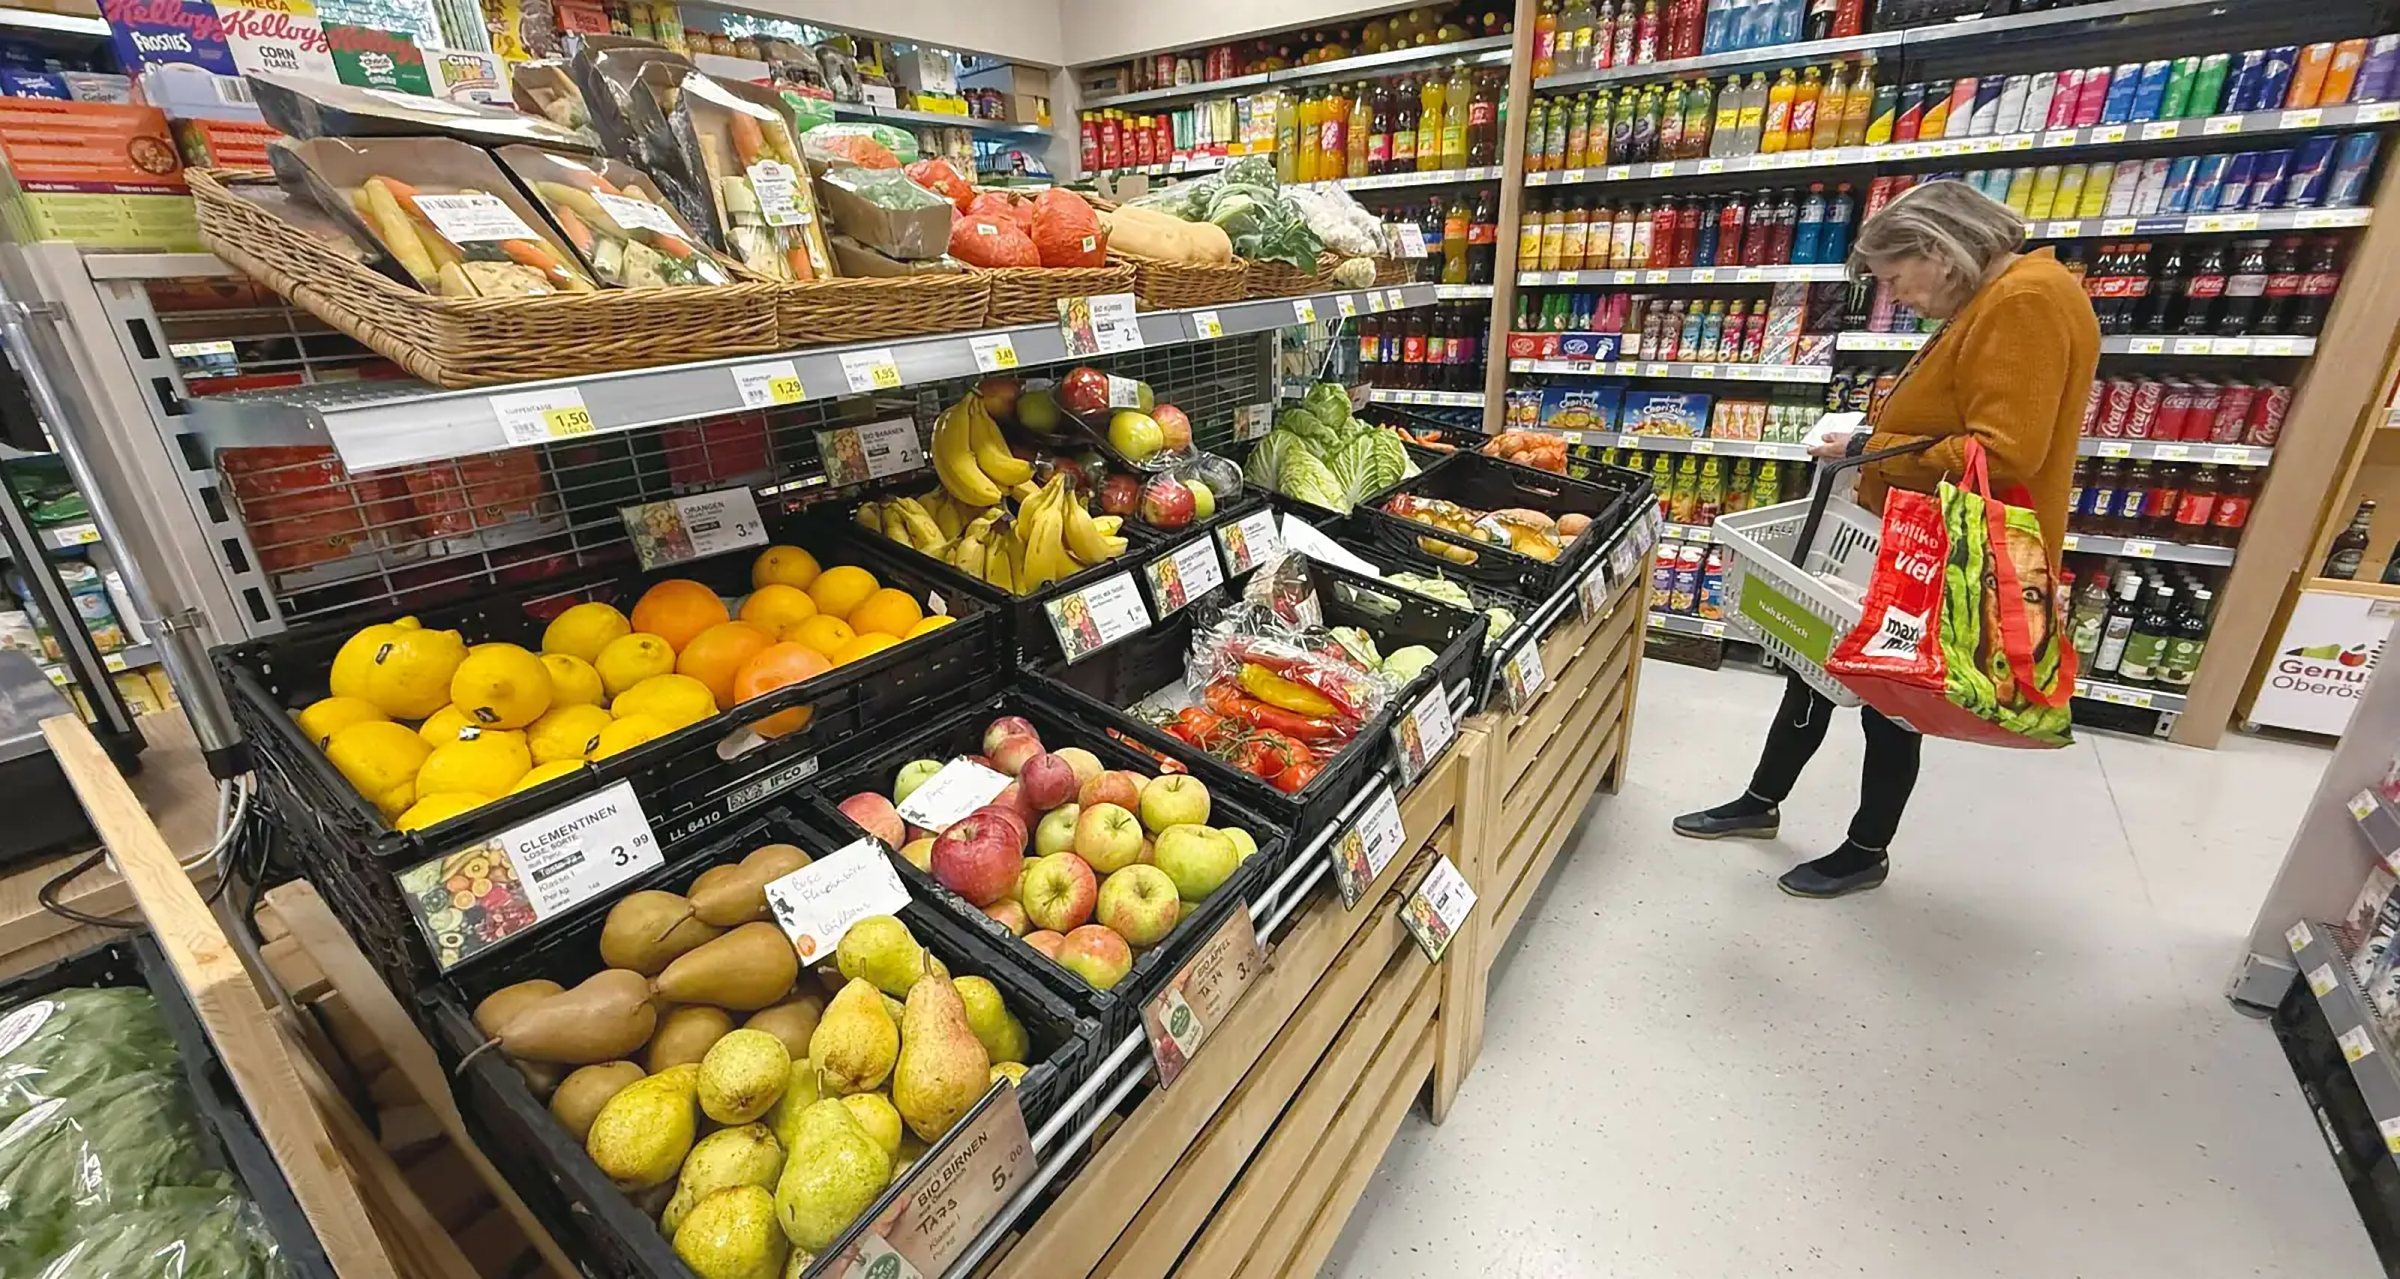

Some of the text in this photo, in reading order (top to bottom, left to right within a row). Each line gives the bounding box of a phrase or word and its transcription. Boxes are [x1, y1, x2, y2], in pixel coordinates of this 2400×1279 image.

[130, 31, 193, 53] FROSTIES
[259, 46, 297, 61] CORN
[448, 54, 482, 67] CINI
[263, 58, 300, 71] FLAKES
[874, 367, 896, 382] 1,95
[777, 380, 801, 396] 1,29
[555, 411, 590, 428] 1,50
[684, 501, 725, 515] ORANGEN
[770, 766, 802, 788] IFCO
[520, 804, 618, 854] CLEMENTINEN
[669, 811, 722, 842] LL 6410
[610, 833, 650, 867] 3.99
[916, 1179, 942, 1209] BIO
[941, 1131, 990, 1184] BIRNEN
[990, 1144, 1025, 1193] 5.00
